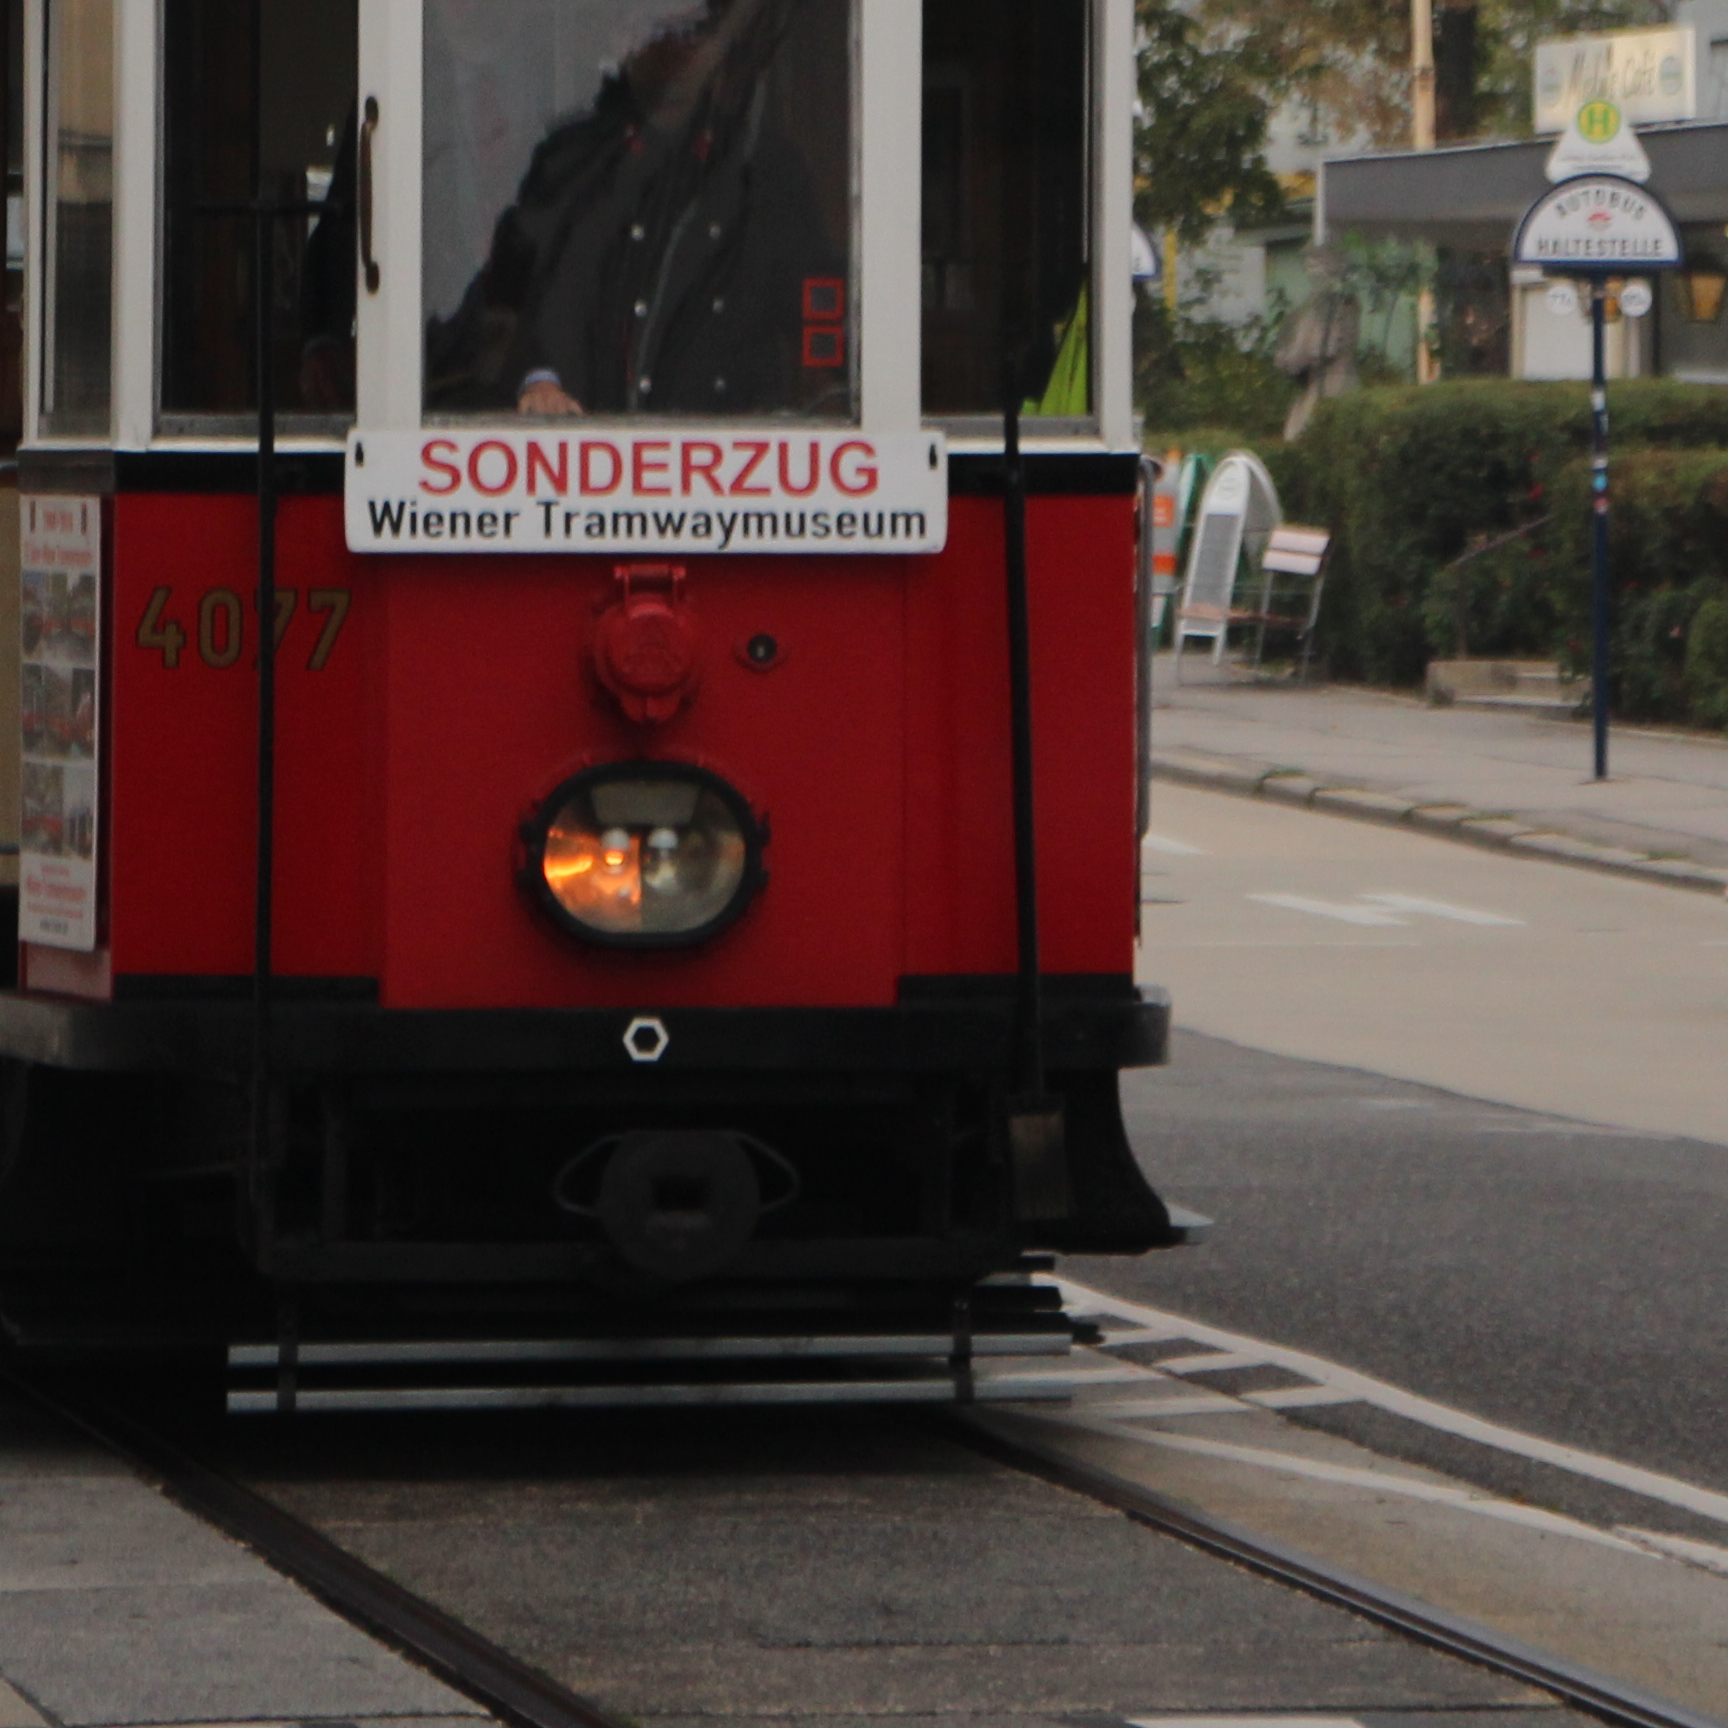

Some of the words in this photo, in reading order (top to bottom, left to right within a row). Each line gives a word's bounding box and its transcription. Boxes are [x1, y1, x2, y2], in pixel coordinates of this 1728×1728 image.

[1556, 189, 1646, 219] AUTOBUS
[1537, 237, 1663, 257] HALTESTELLE
[418, 439, 879, 498] SONDERZUG
[369, 500, 521, 540] Wiener
[537, 500, 927, 550] Tramwaymuseum
[136, 585, 353, 671] 4077
